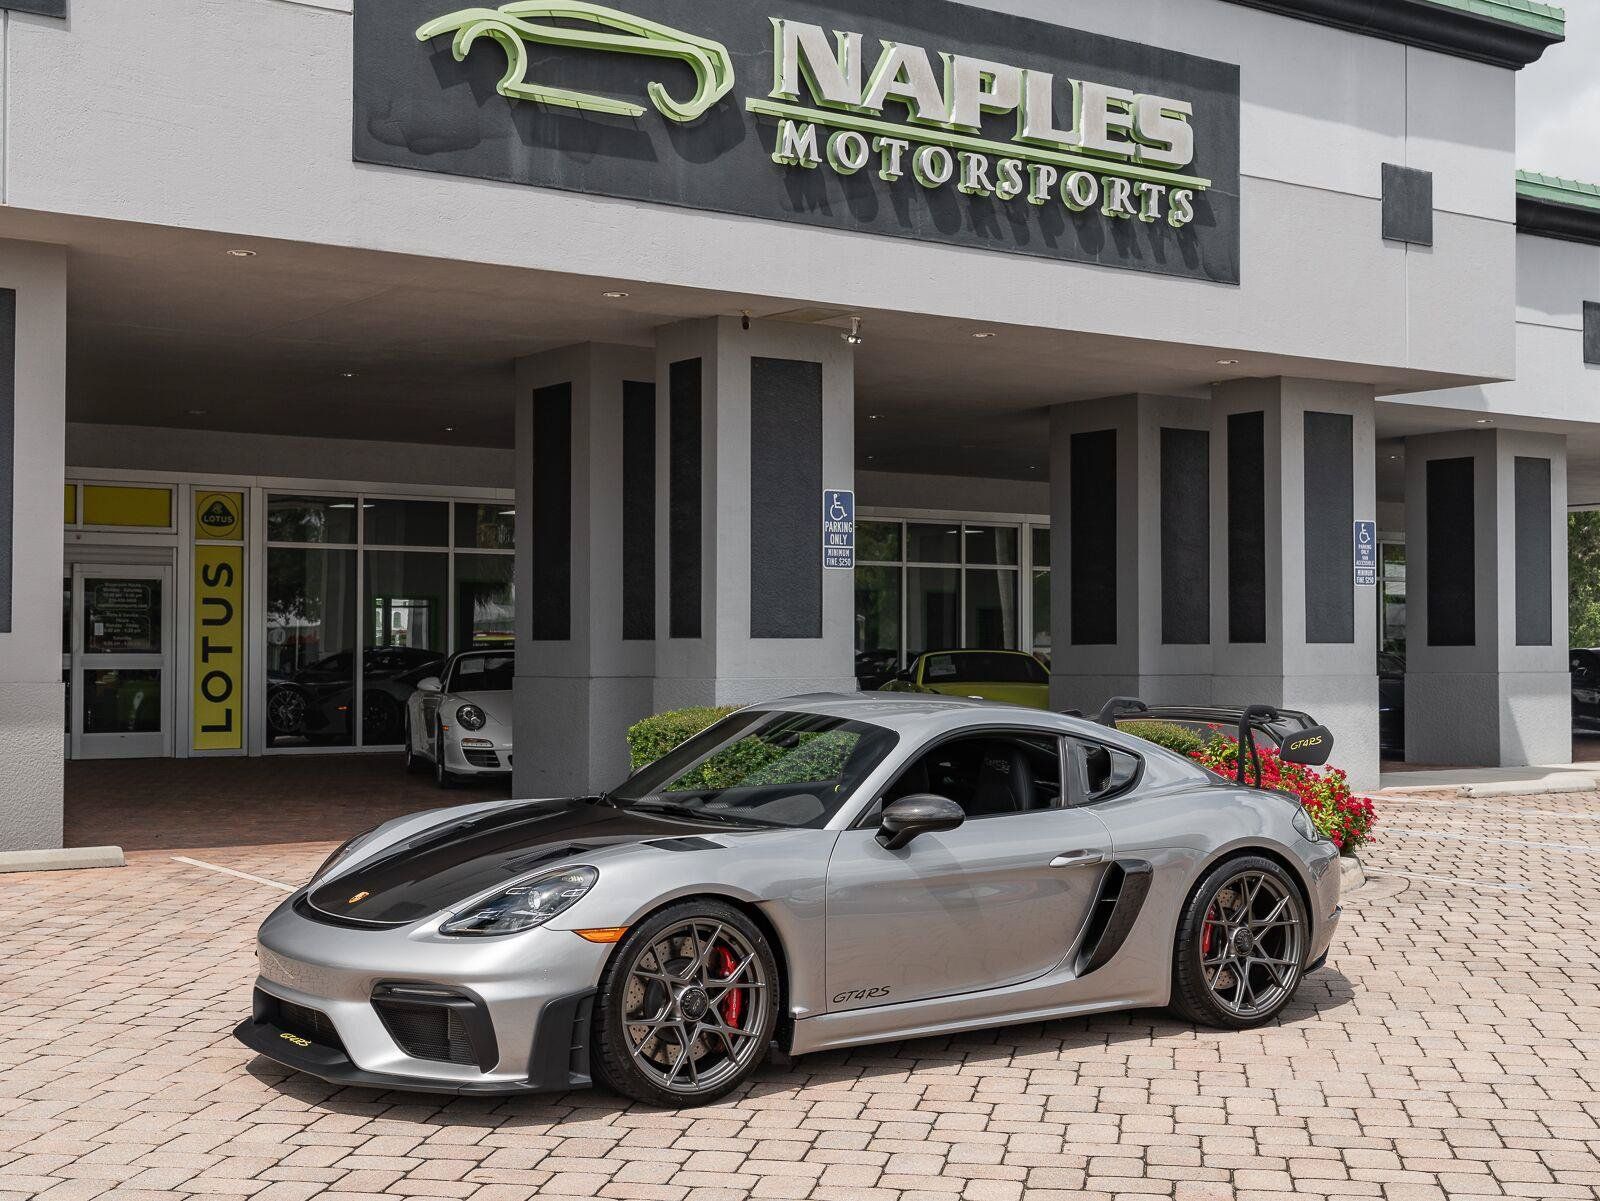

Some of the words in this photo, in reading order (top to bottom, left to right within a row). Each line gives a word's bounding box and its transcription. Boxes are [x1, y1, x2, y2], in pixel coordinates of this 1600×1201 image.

[768, 17, 1194, 170] NAPLES
[772, 119, 1194, 228] MOTORSPORTS
[825, 521, 852, 532] PARKING
[830, 534, 848, 545] ONLY
[827, 549, 850, 557] MINIMUM
[826, 558, 837, 566] FINE
[839, 558, 851, 567] $250
[202, 562, 233, 732] LOTUS
[1291, 736, 1322, 750] GT4RS
[832, 985, 891, 1003] GT4RS
